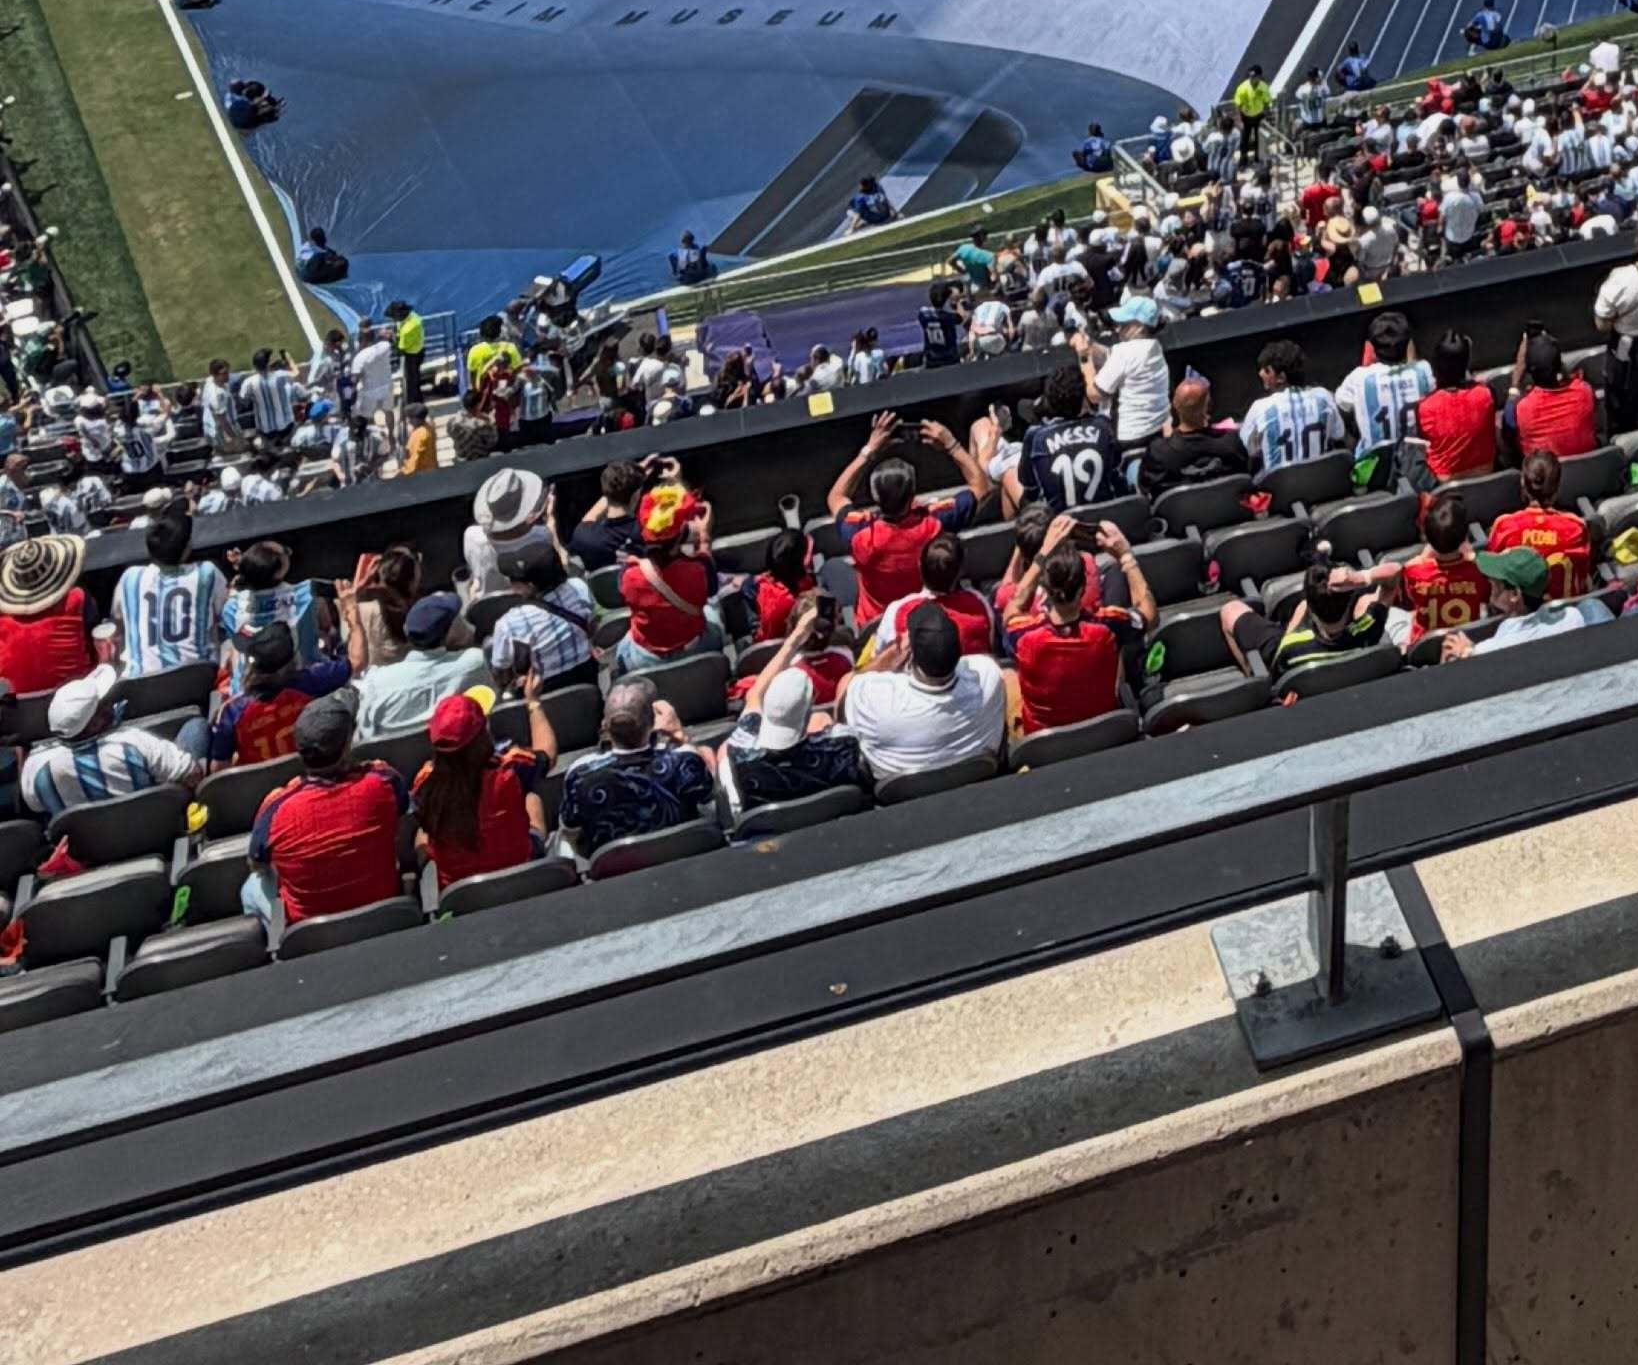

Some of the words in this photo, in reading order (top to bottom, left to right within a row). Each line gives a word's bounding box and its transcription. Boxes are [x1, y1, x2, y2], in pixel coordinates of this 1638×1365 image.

[614, 8, 900, 31] MUSEUM
[1045, 425, 1101, 455] MESSI
[1051, 447, 1103, 508] 19
[143, 586, 193, 646] 10
